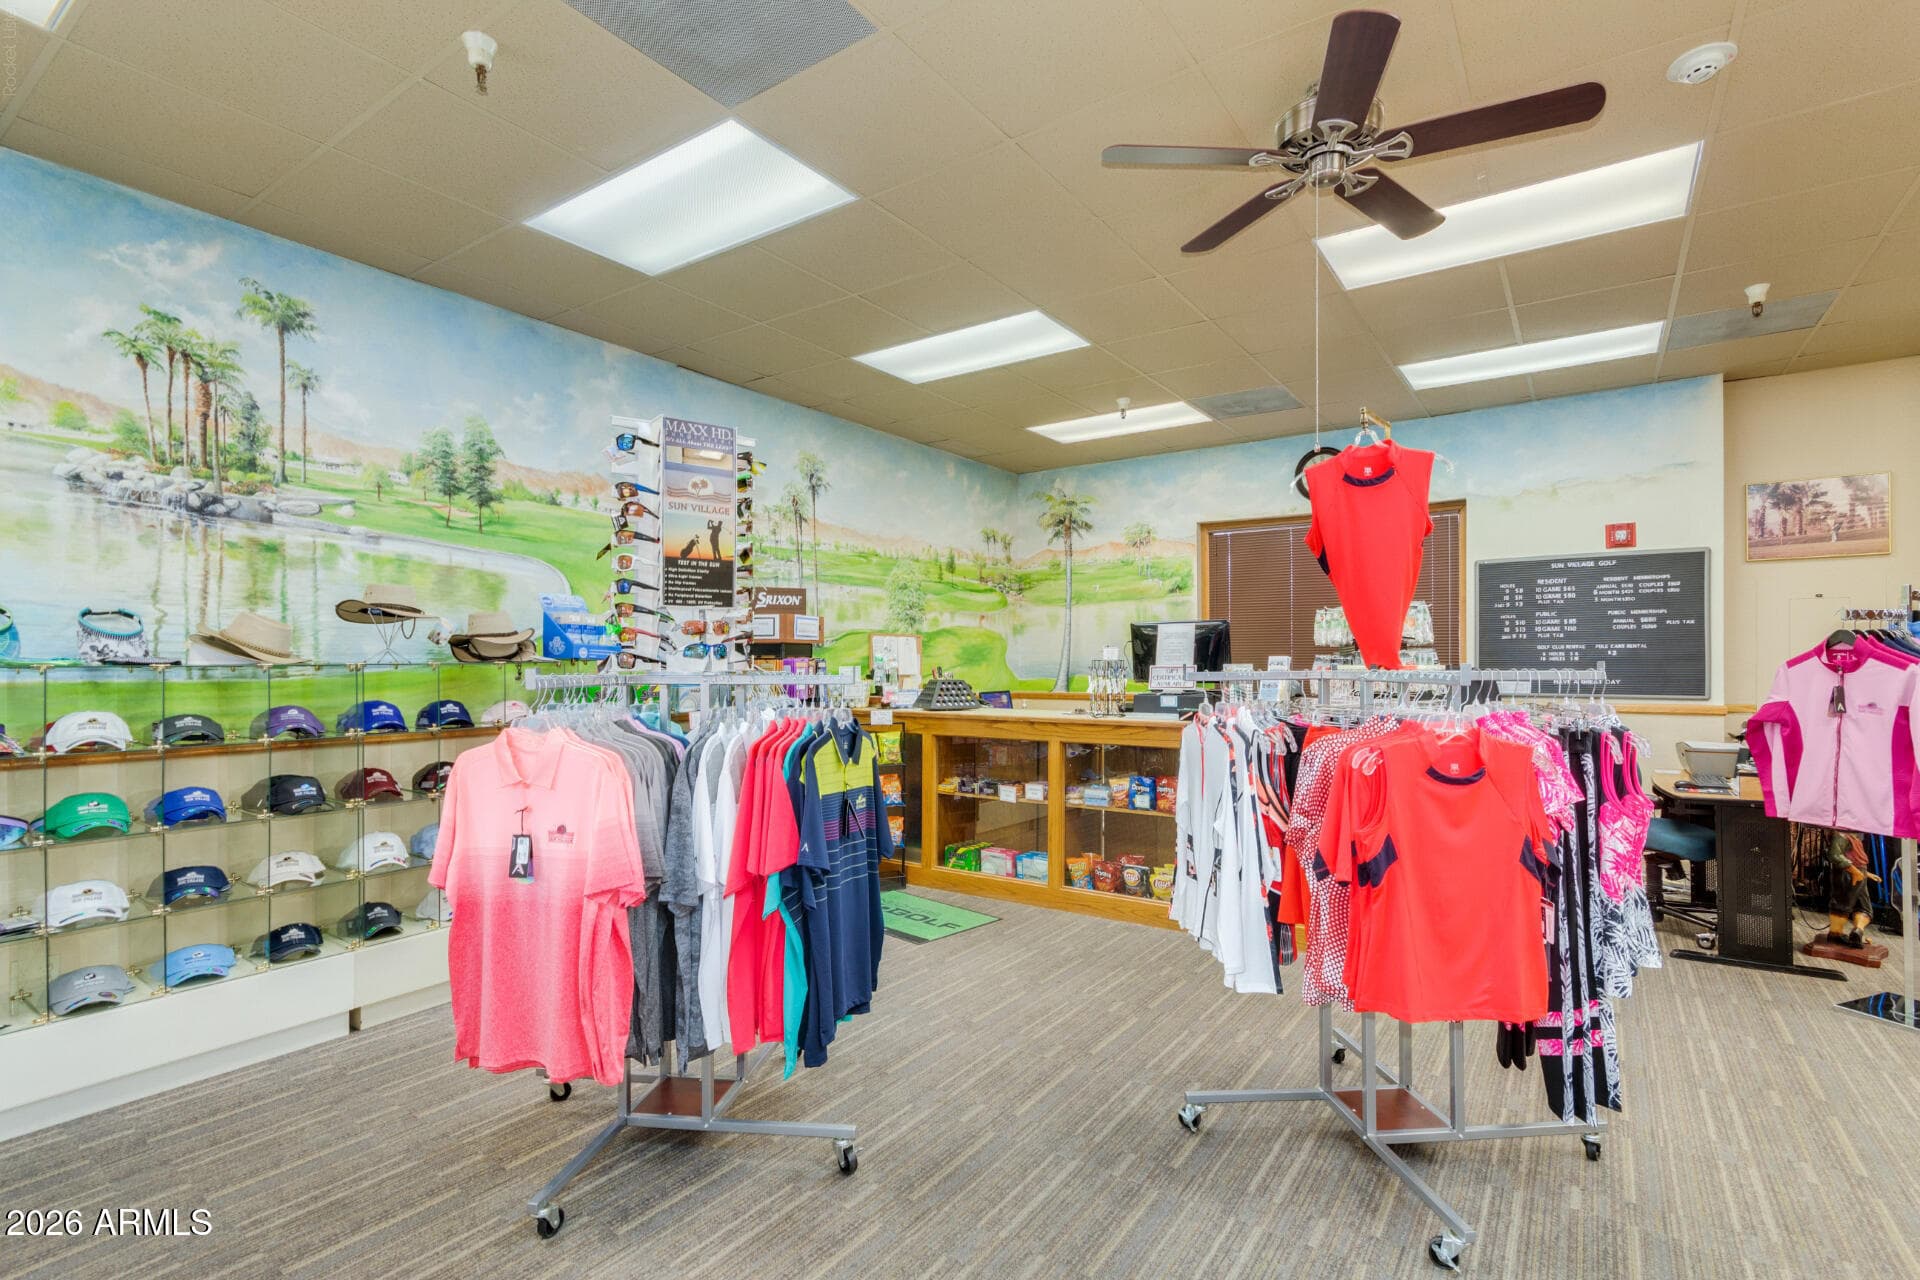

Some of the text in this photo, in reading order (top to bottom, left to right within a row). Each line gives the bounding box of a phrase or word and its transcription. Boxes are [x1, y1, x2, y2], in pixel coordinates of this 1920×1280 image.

[666, 420, 708, 437] MAXX
[668, 501, 730, 516] SUN VILLAGE
[1567, 560, 1595, 569] VILLAGE
[1598, 559, 1617, 567] GOLF
[755, 591, 802, 609] SRIXON
[886, 907, 963, 929] GOLF
